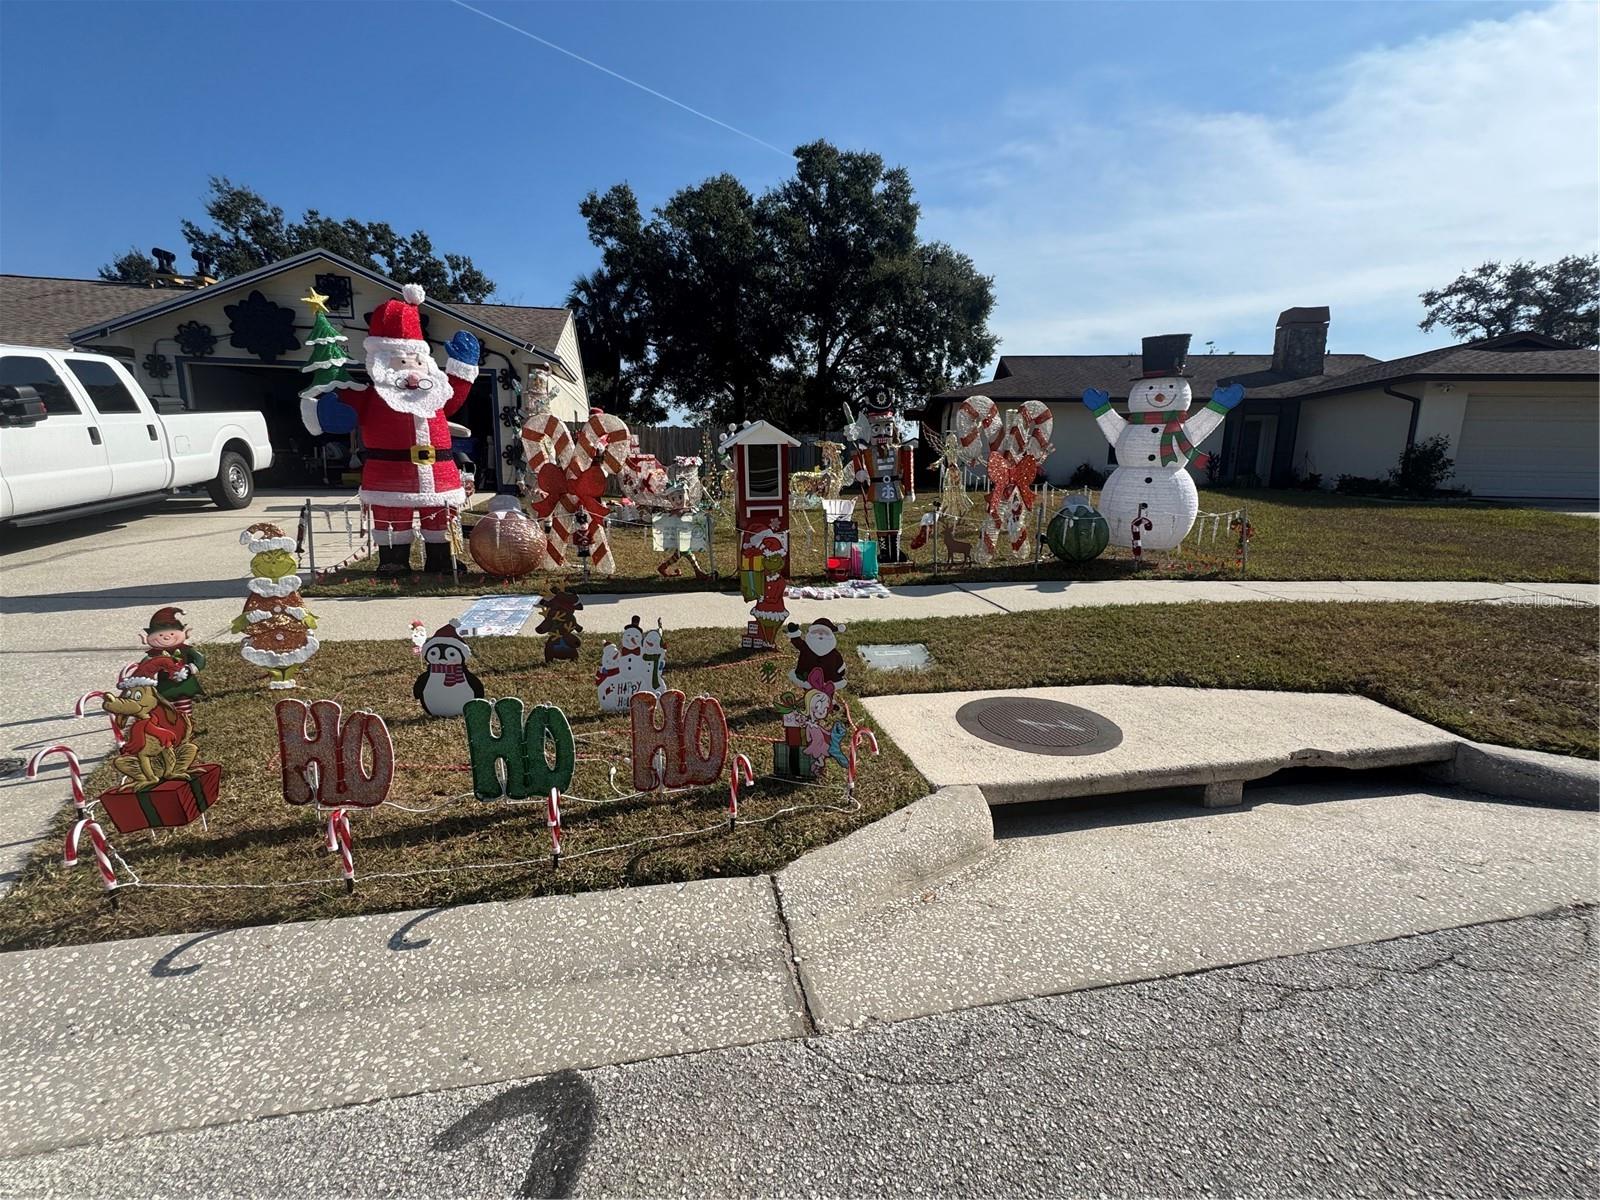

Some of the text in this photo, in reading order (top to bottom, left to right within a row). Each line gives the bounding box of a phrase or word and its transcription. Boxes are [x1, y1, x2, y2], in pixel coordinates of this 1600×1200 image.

[275, 689, 728, 807] HO HO HO
